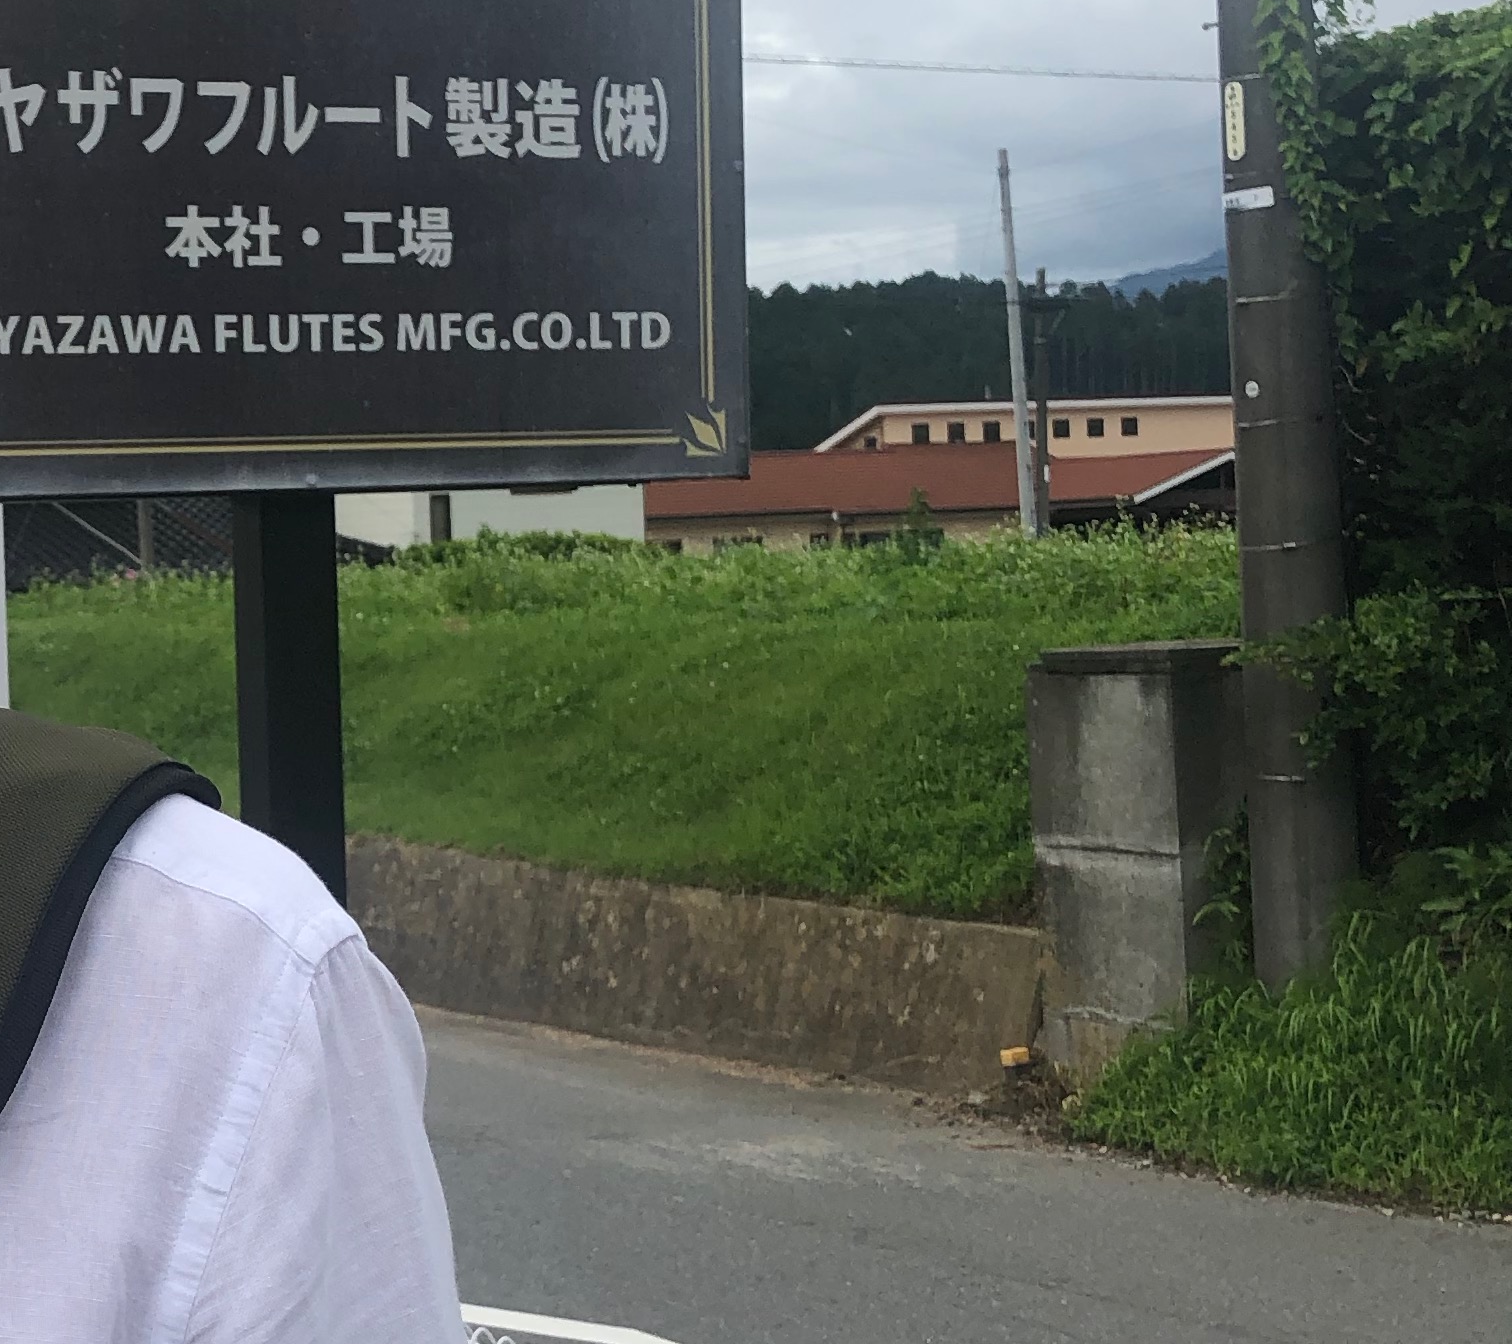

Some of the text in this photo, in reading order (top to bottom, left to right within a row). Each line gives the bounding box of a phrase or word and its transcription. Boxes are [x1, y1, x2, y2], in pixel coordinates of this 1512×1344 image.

[164, 204, 454, 268] 本社・工場
[214, 312, 385, 354] FLUTES
[396, 310, 672, 353] MFG.CO.LTD
